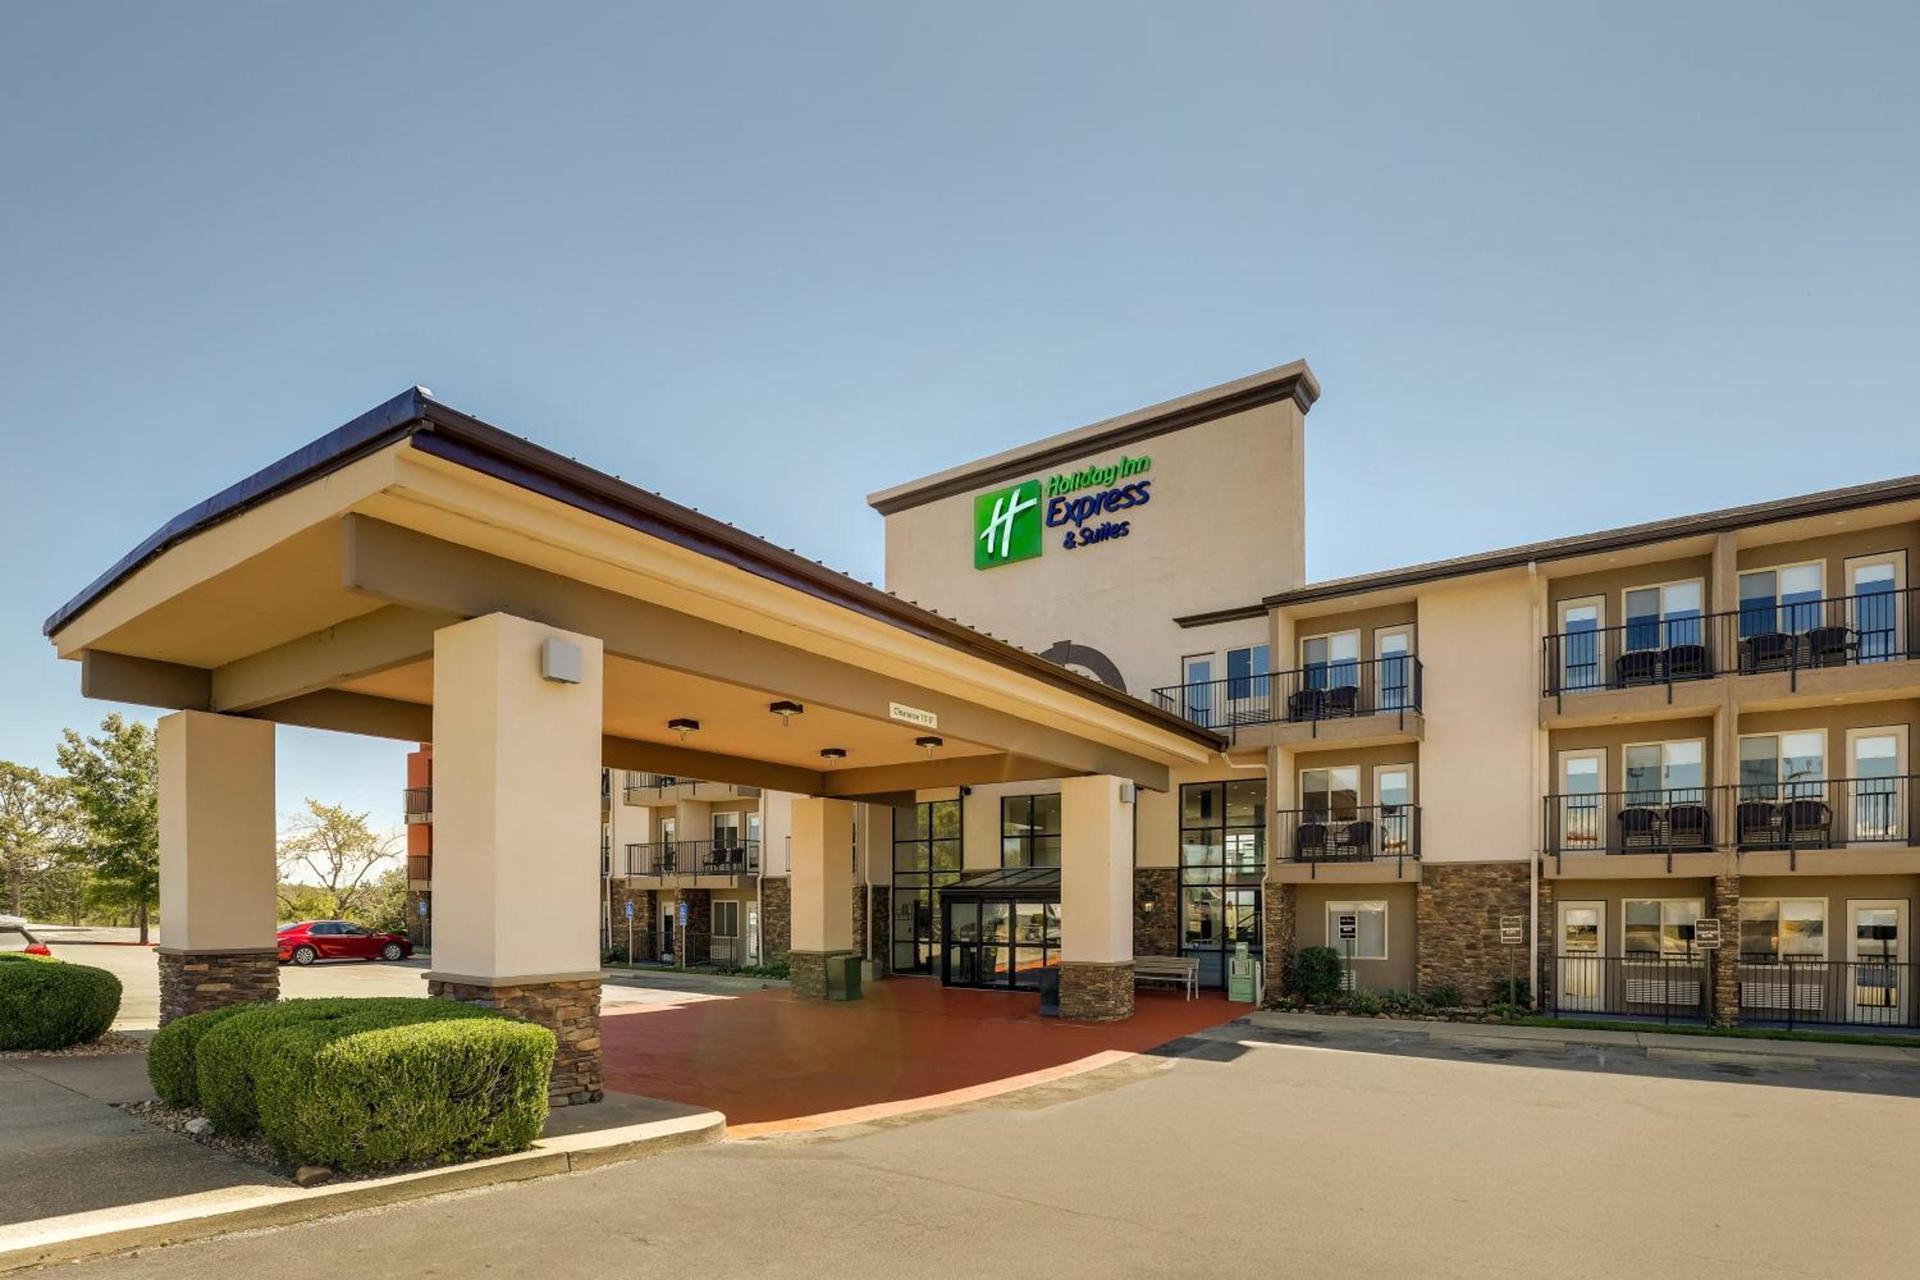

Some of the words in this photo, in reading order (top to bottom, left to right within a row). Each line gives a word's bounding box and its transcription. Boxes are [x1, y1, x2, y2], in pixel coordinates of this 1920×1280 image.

[1046, 464, 1118, 497] Holiday
[1118, 455, 1152, 478] Inn
[1045, 480, 1152, 528] Express
[1063, 531, 1077, 550] &
[1077, 521, 1130, 546] Suites
